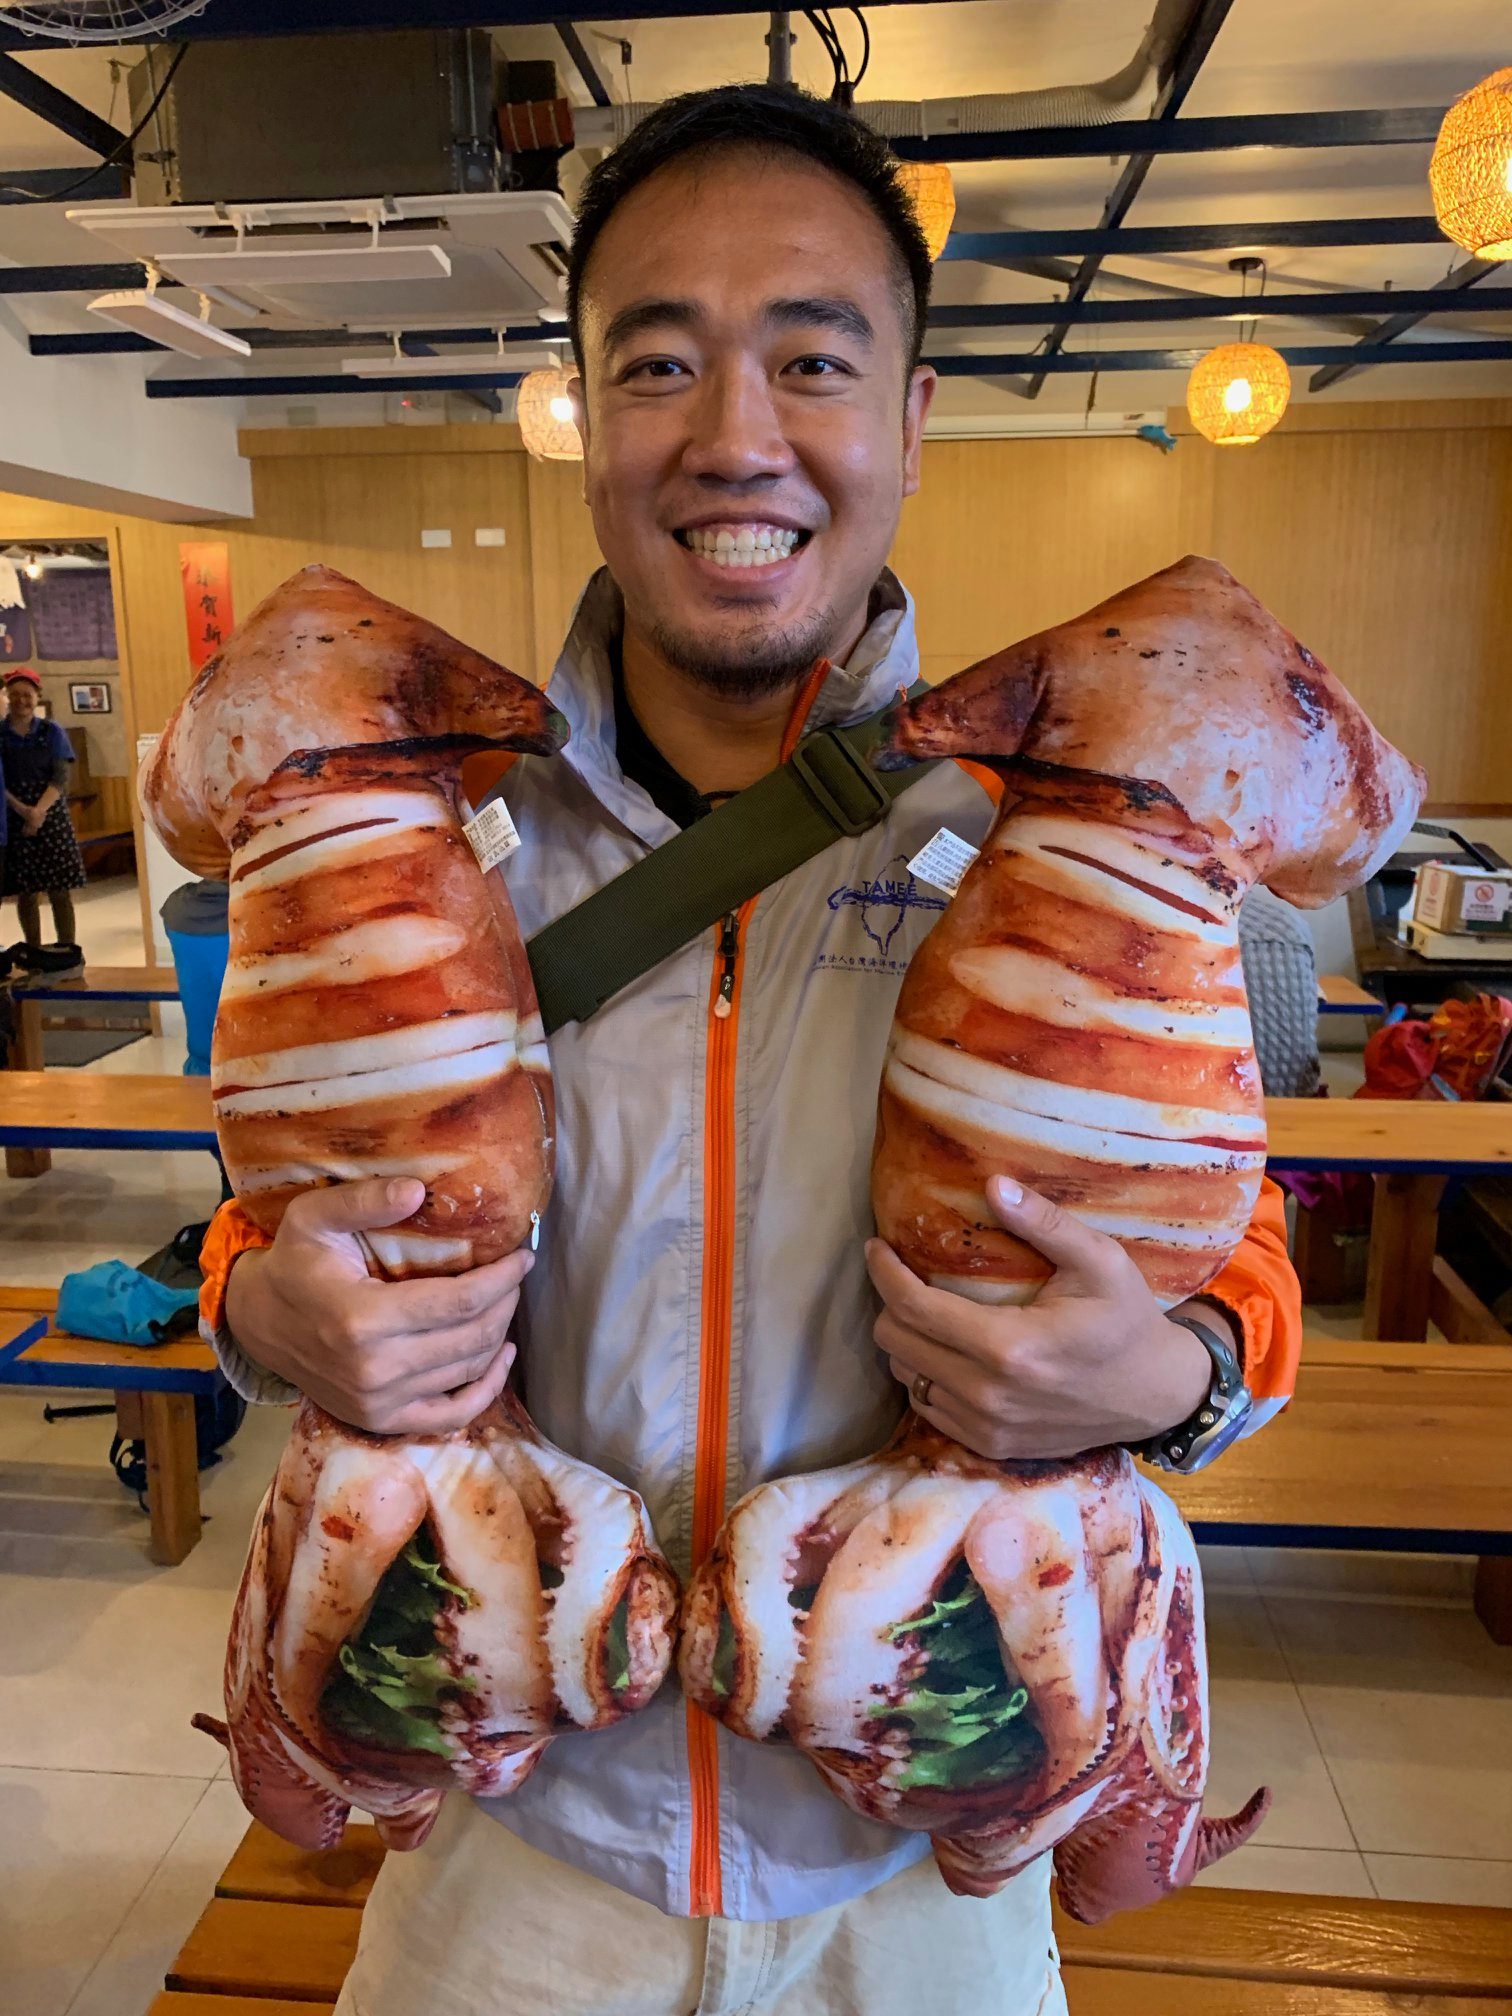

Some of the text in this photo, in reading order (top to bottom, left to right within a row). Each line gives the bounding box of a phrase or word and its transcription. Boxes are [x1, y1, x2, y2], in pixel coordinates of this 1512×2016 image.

[197, 568, 221, 659] 恭賀新
[862, 880, 917, 896] TAMEE
